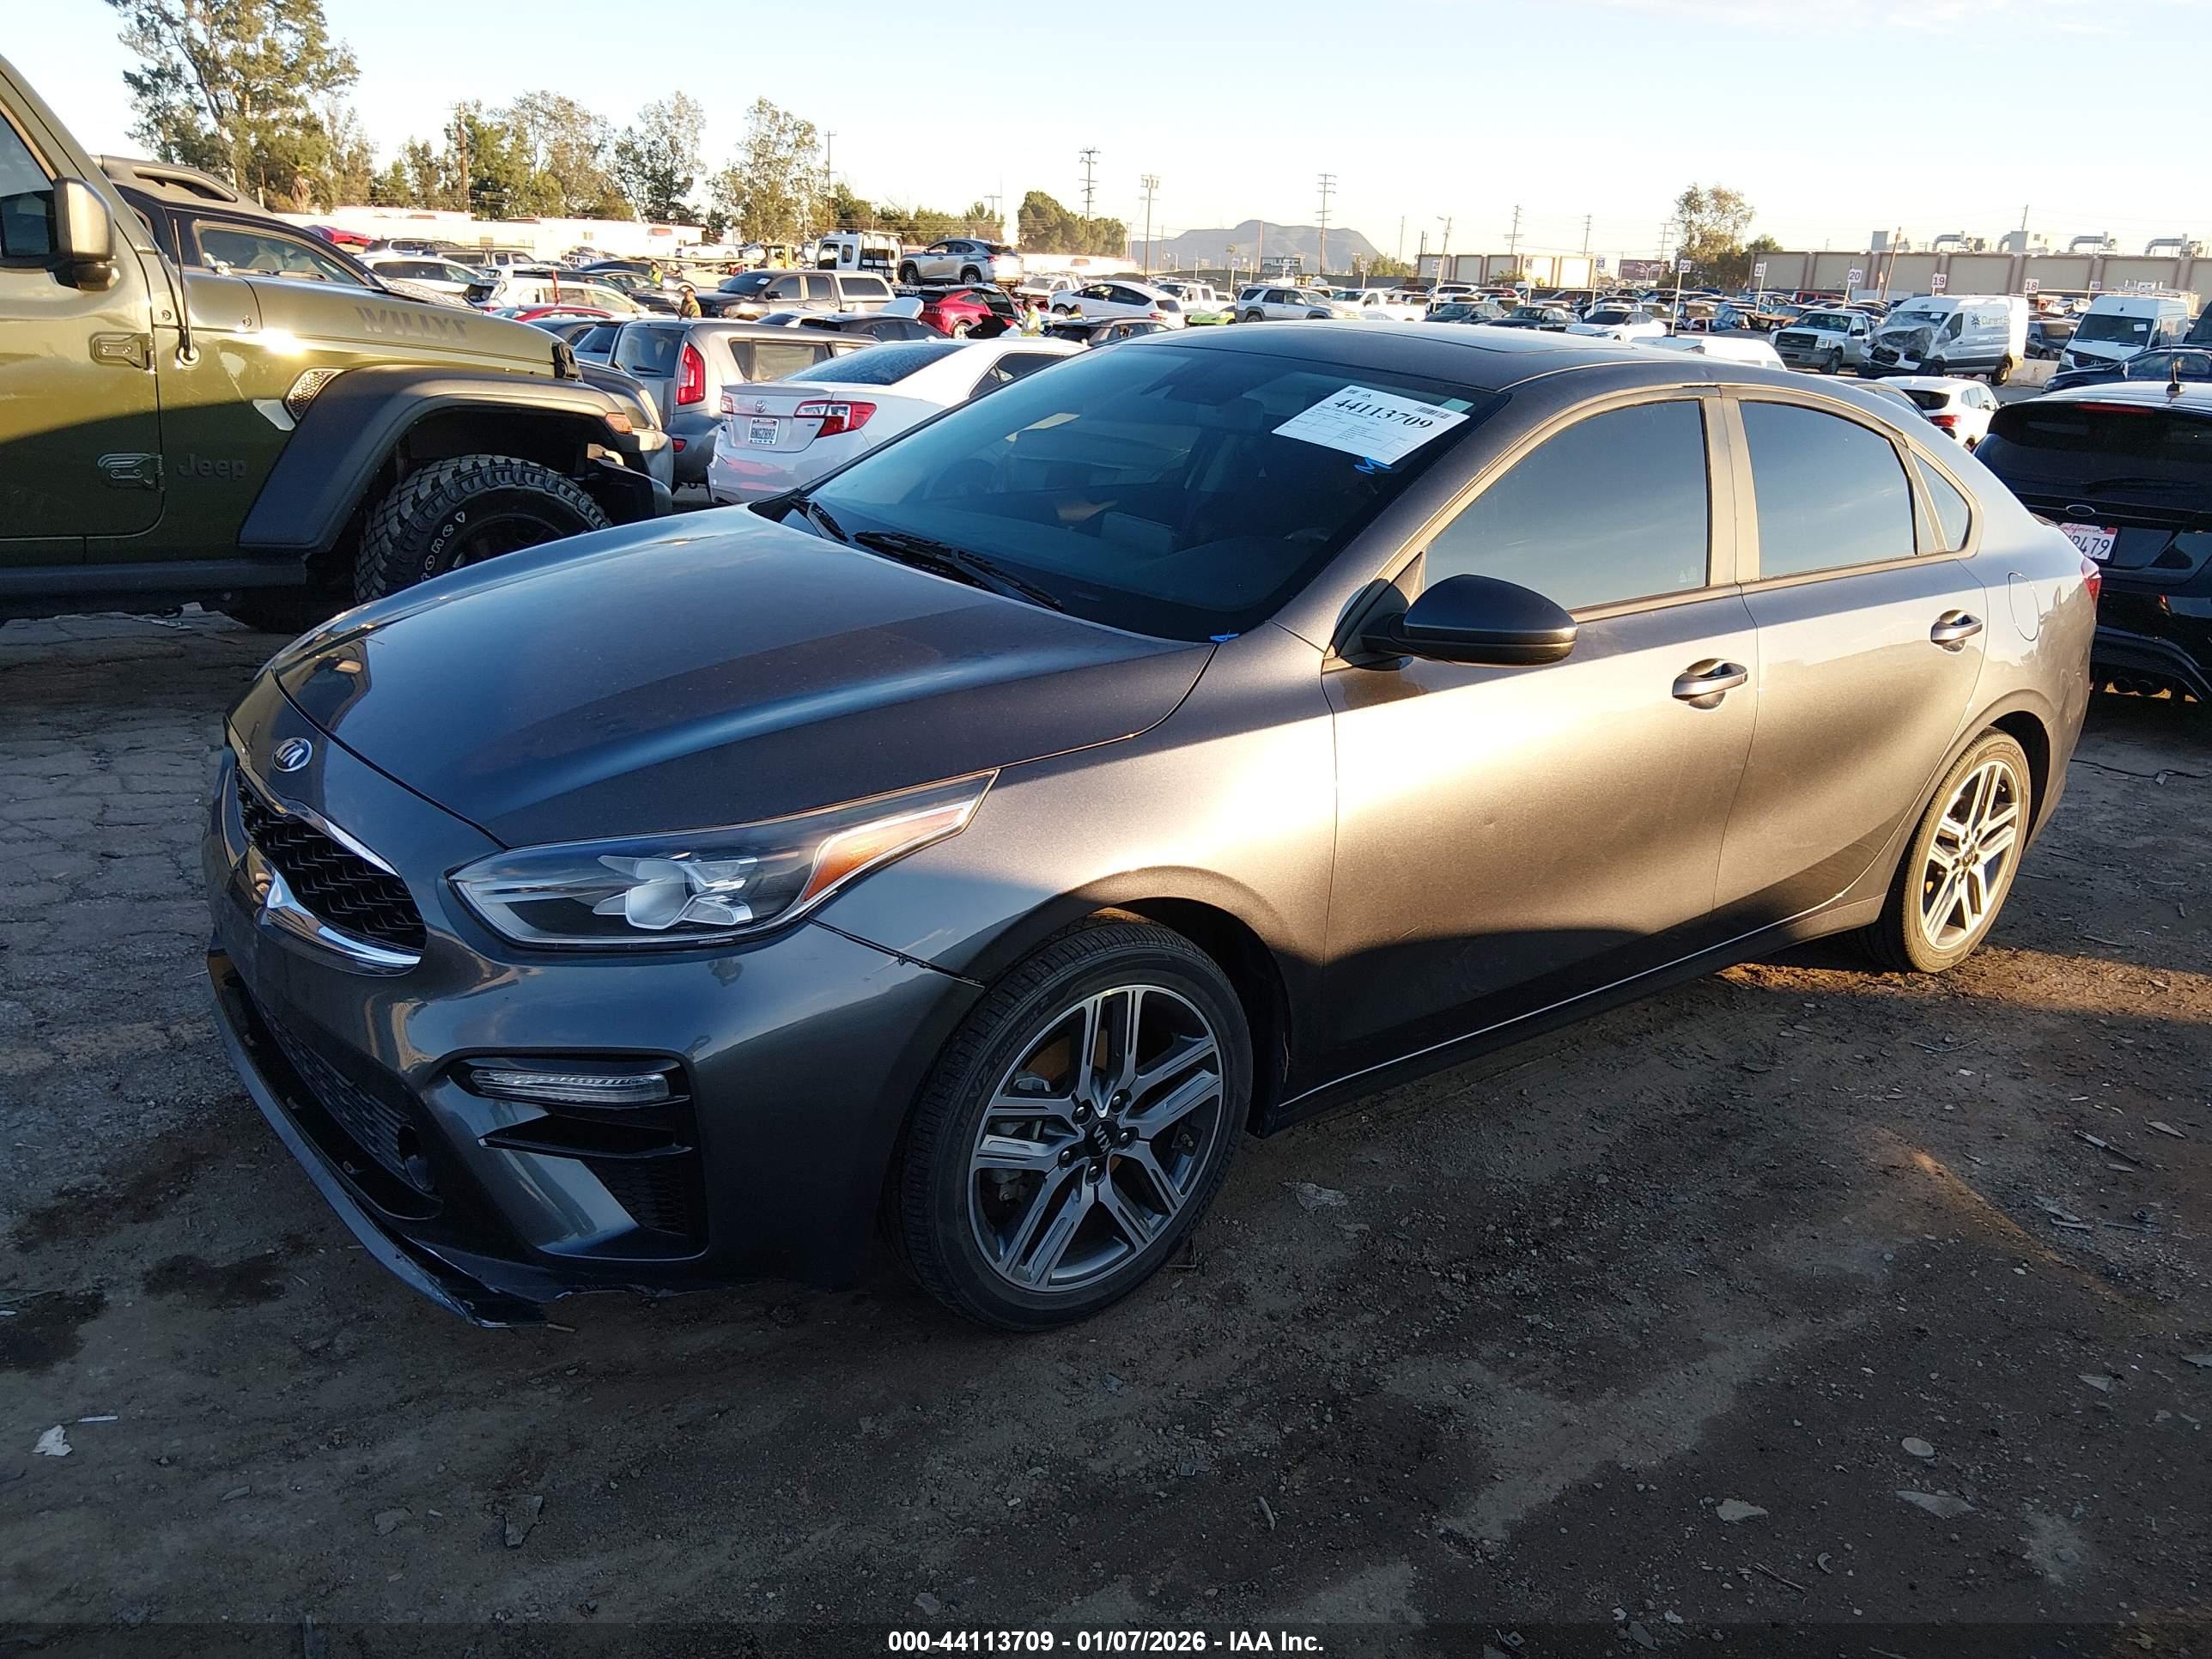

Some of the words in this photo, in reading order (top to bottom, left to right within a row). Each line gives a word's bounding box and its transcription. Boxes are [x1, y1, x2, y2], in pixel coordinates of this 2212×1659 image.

[1595, 259, 1605, 268] 23
[1848, 271, 1861, 280] 20
[1932, 276, 1945, 286] 19
[2025, 282, 2038, 291] 18
[1334, 398, 1433, 428] 44113709
[178, 453, 248, 481] Jeep
[2069, 534, 2110, 556] 479
[1093, 1124, 1112, 1152] KIA
